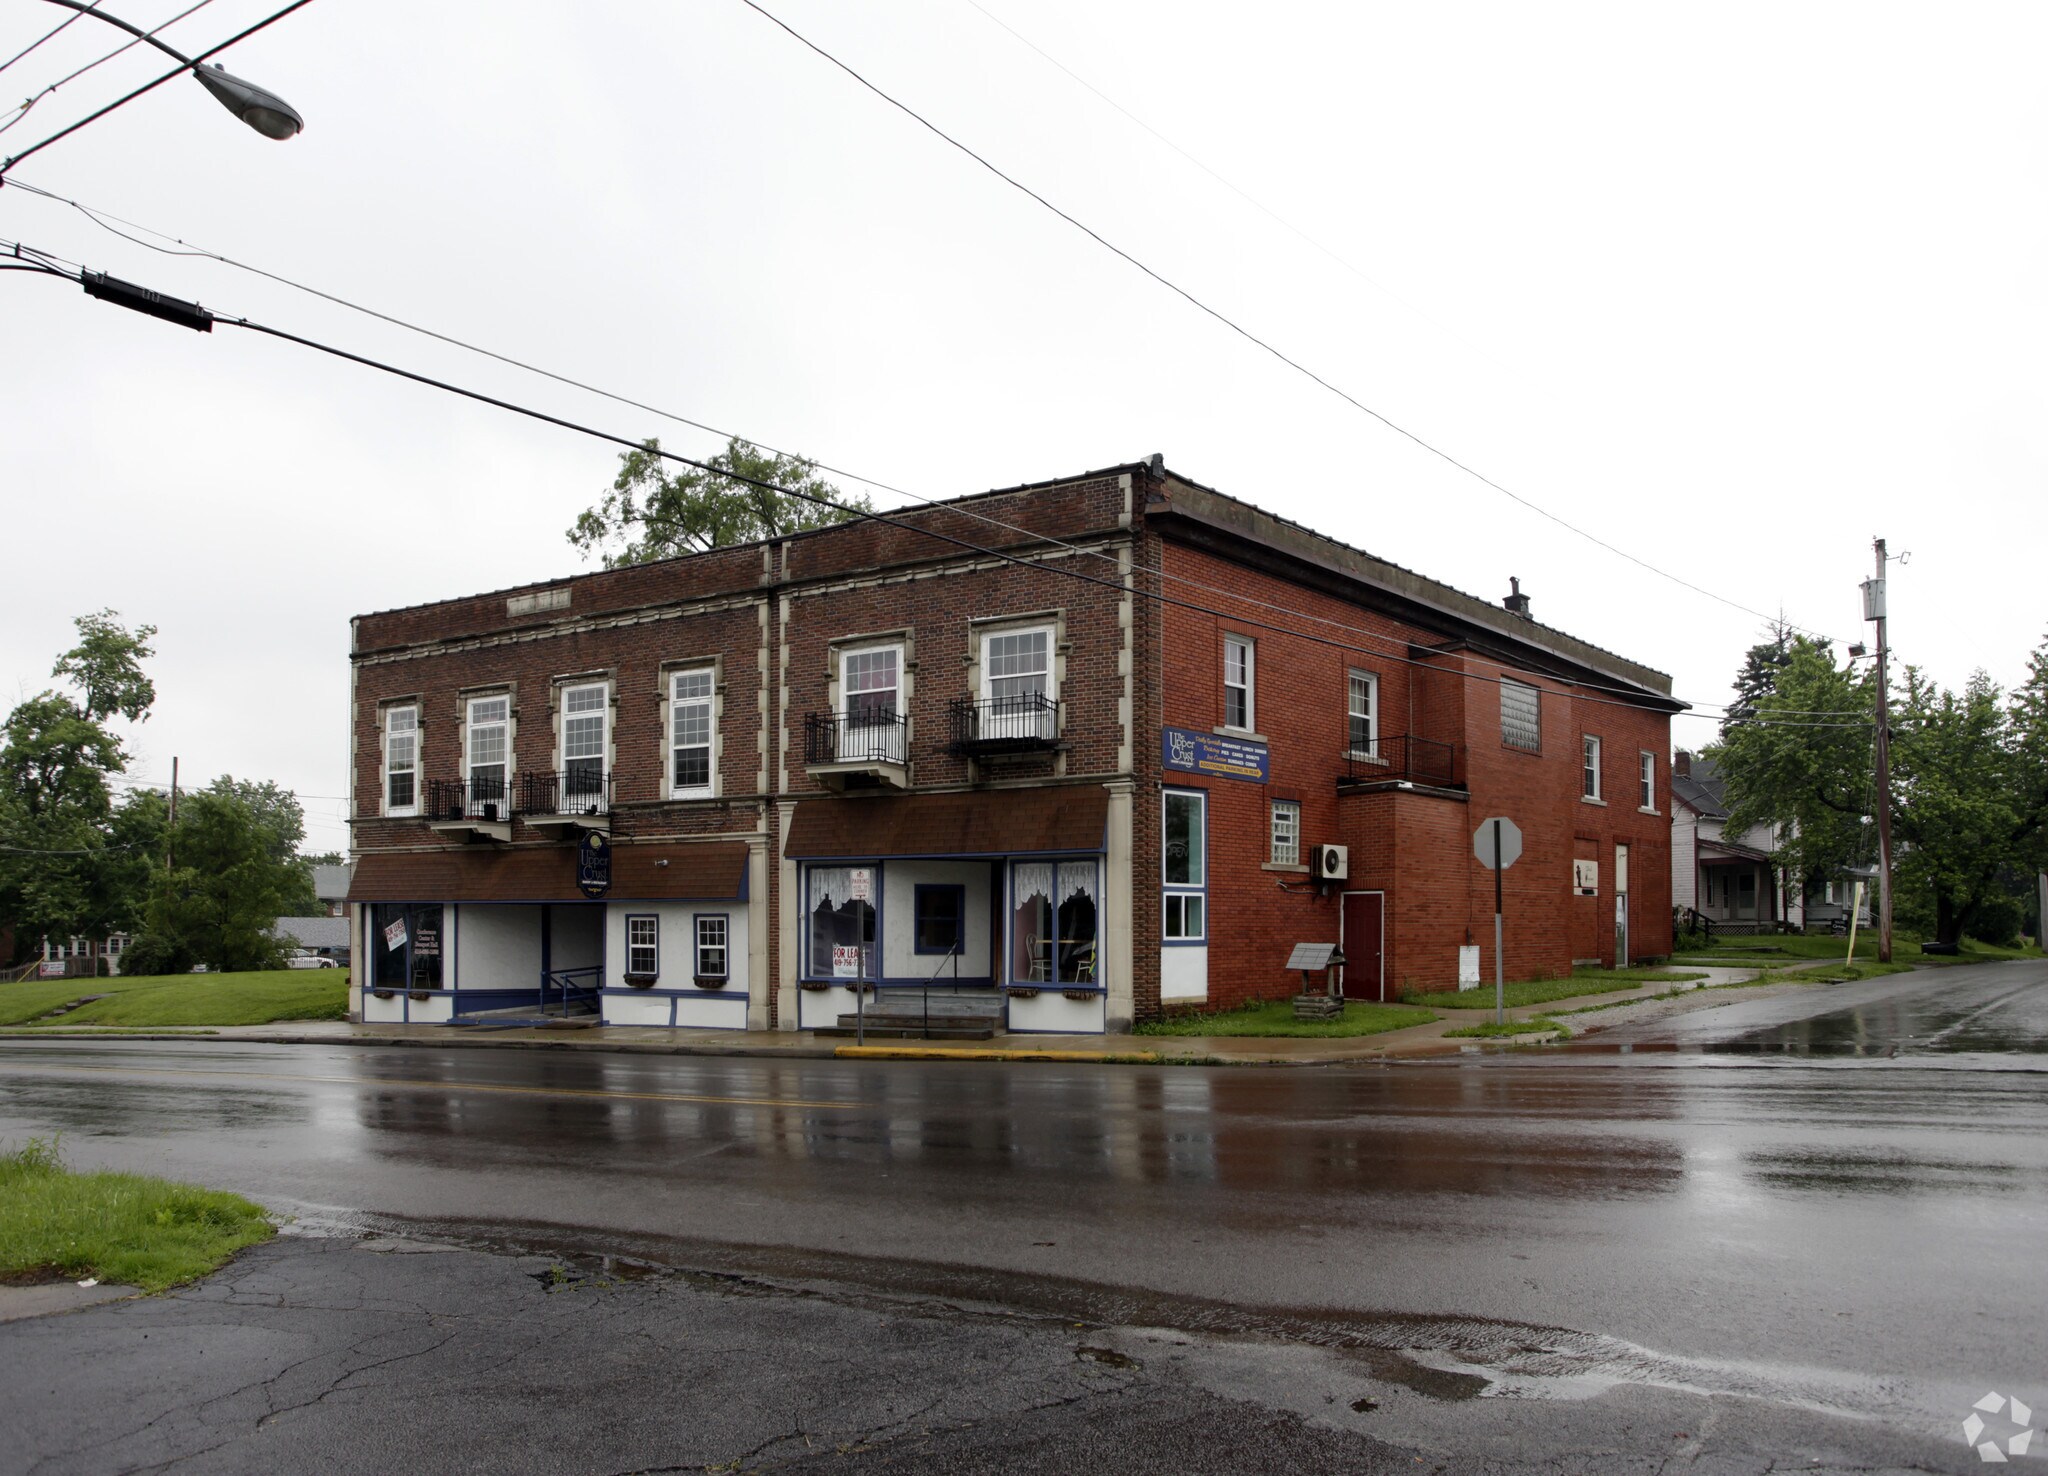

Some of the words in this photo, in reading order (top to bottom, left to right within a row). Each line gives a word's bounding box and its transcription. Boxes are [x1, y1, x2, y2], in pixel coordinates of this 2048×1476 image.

[1169, 732, 1195, 750] Upper
[1172, 746, 1194, 764] Crust
[1201, 762, 1225, 770] ADDITIONAL
[582, 849, 608, 868] Upper
[1167, 846, 1188, 857] OPEN
[583, 865, 607, 881] Crust
[834, 948, 845, 958] FOR
